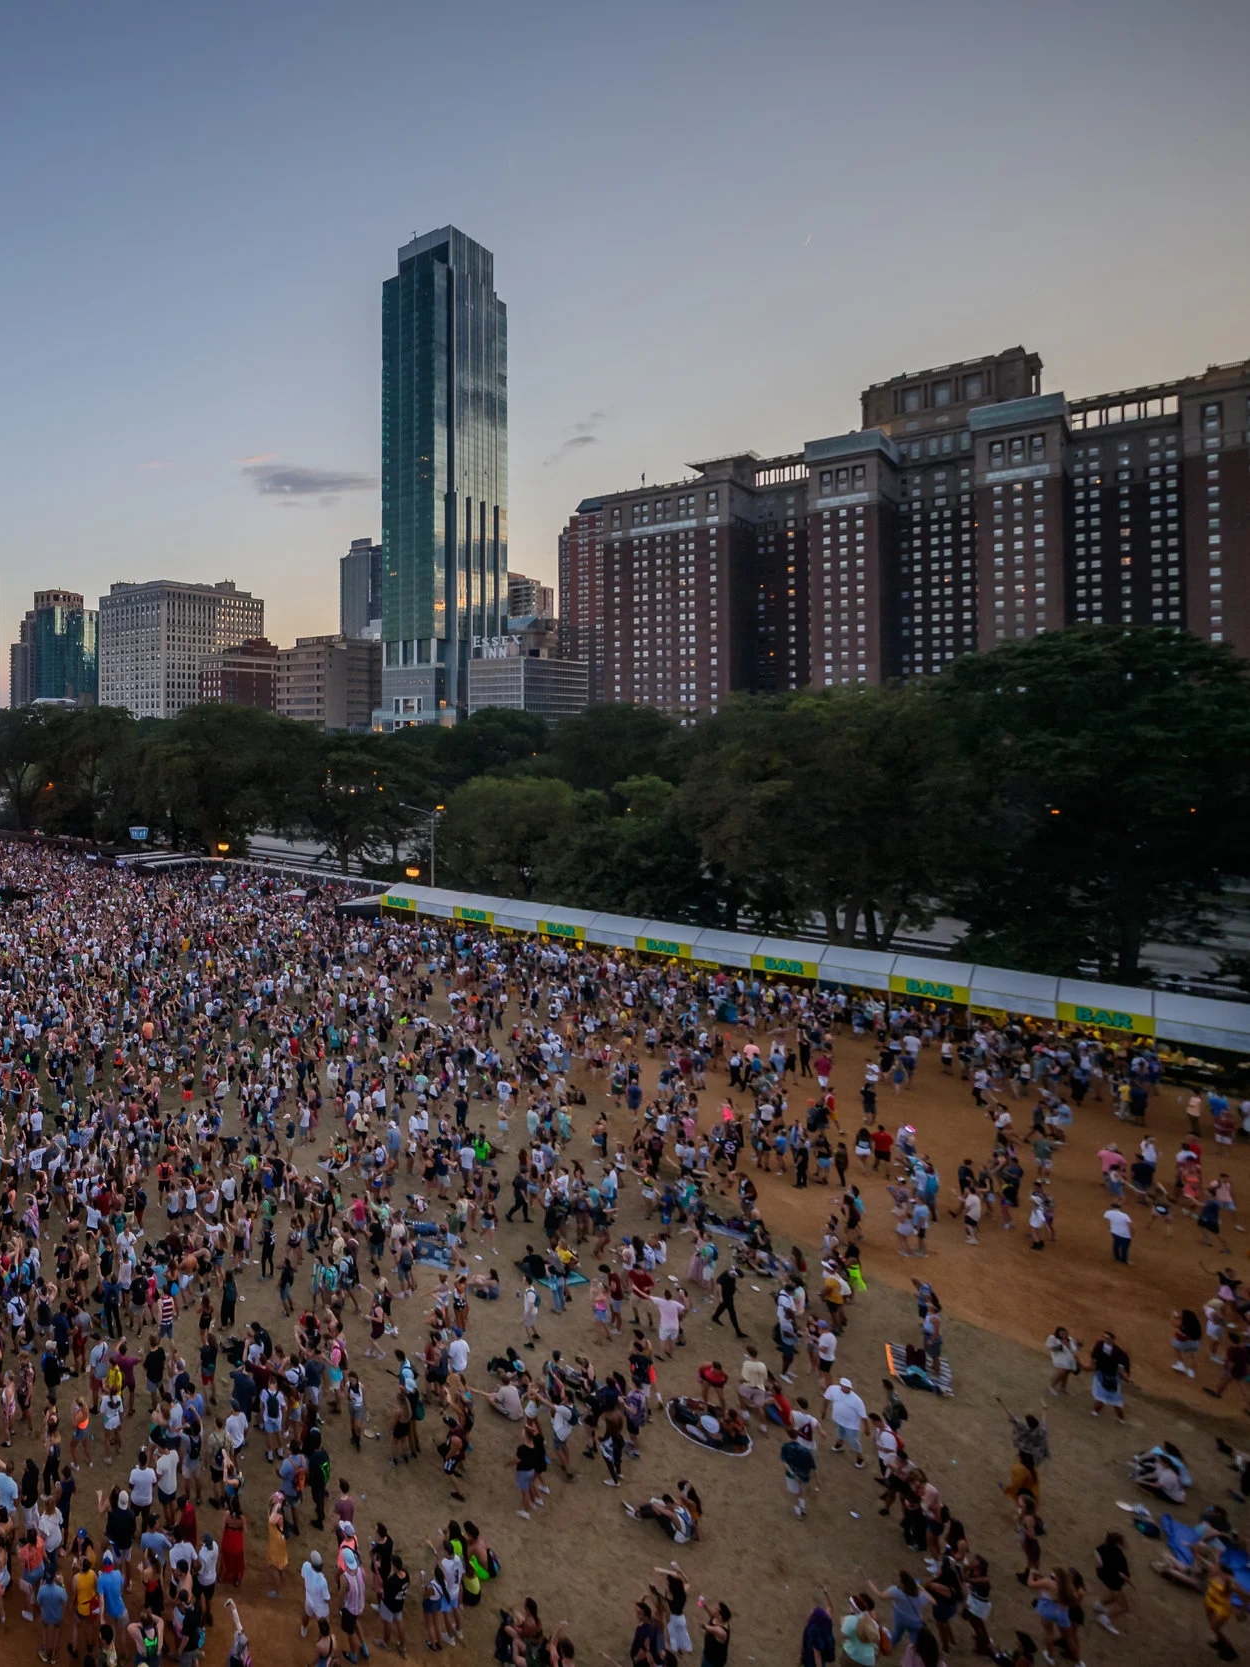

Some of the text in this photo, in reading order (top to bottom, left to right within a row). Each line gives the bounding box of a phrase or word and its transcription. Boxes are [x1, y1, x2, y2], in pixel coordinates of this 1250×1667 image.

[473, 634, 521, 648] ESSEX
[483, 646, 507, 659] INN
[387, 896, 409, 908] BAR
[461, 908, 486, 921] BAR
[547, 922, 576, 937] BAR
[646, 938, 680, 955] BAR
[765, 956, 803, 974] BAR
[906, 978, 954, 999] BAR
[1075, 1006, 1133, 1029] BAR
